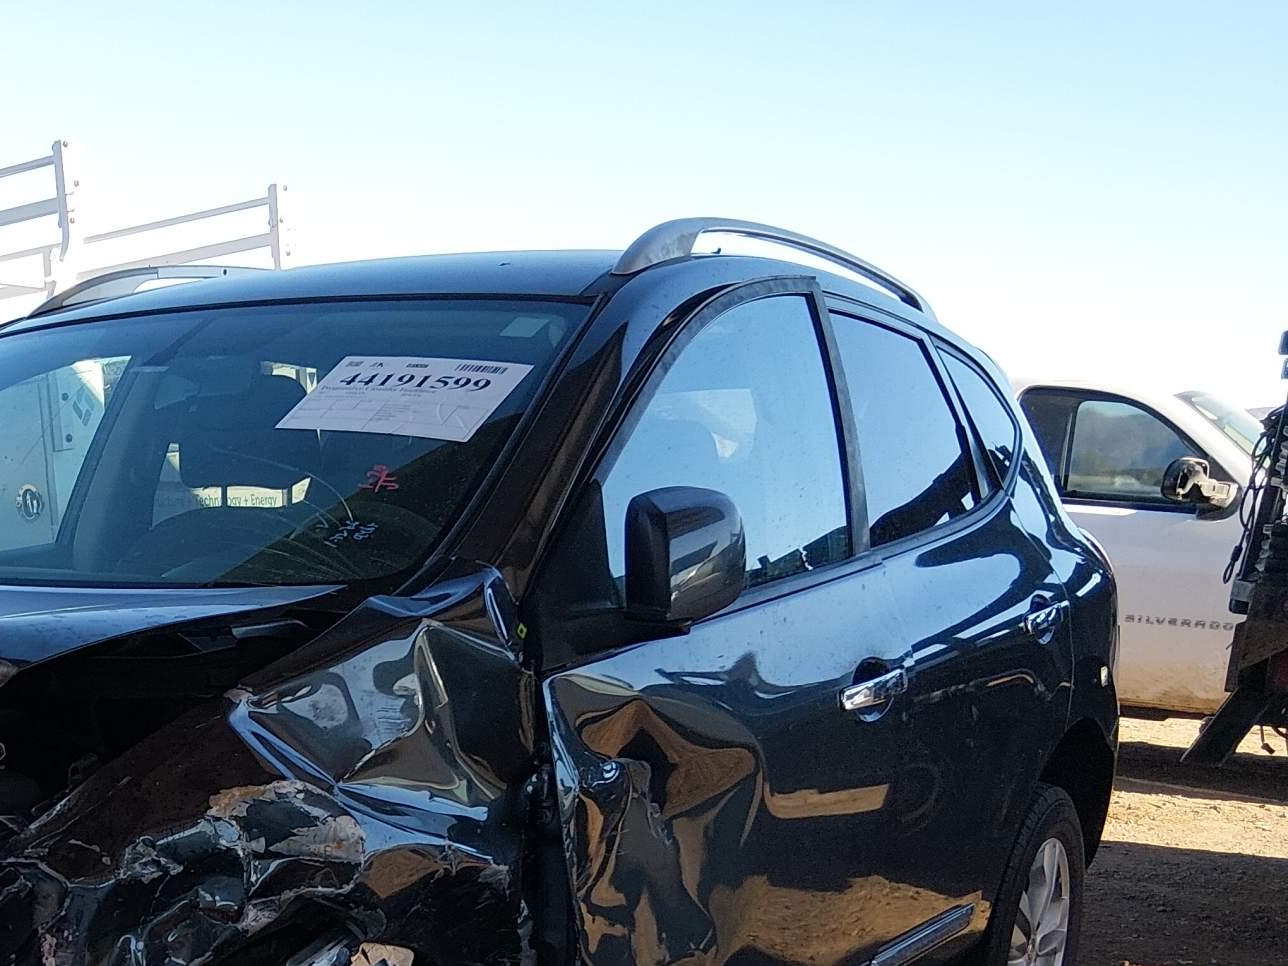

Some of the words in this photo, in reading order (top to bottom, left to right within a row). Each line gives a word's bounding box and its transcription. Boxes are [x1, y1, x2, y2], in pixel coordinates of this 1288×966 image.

[339, 372, 492, 392] 44191599
[250, 493, 277, 507] Energy
[1123, 614, 1234, 631] SILVERADO
